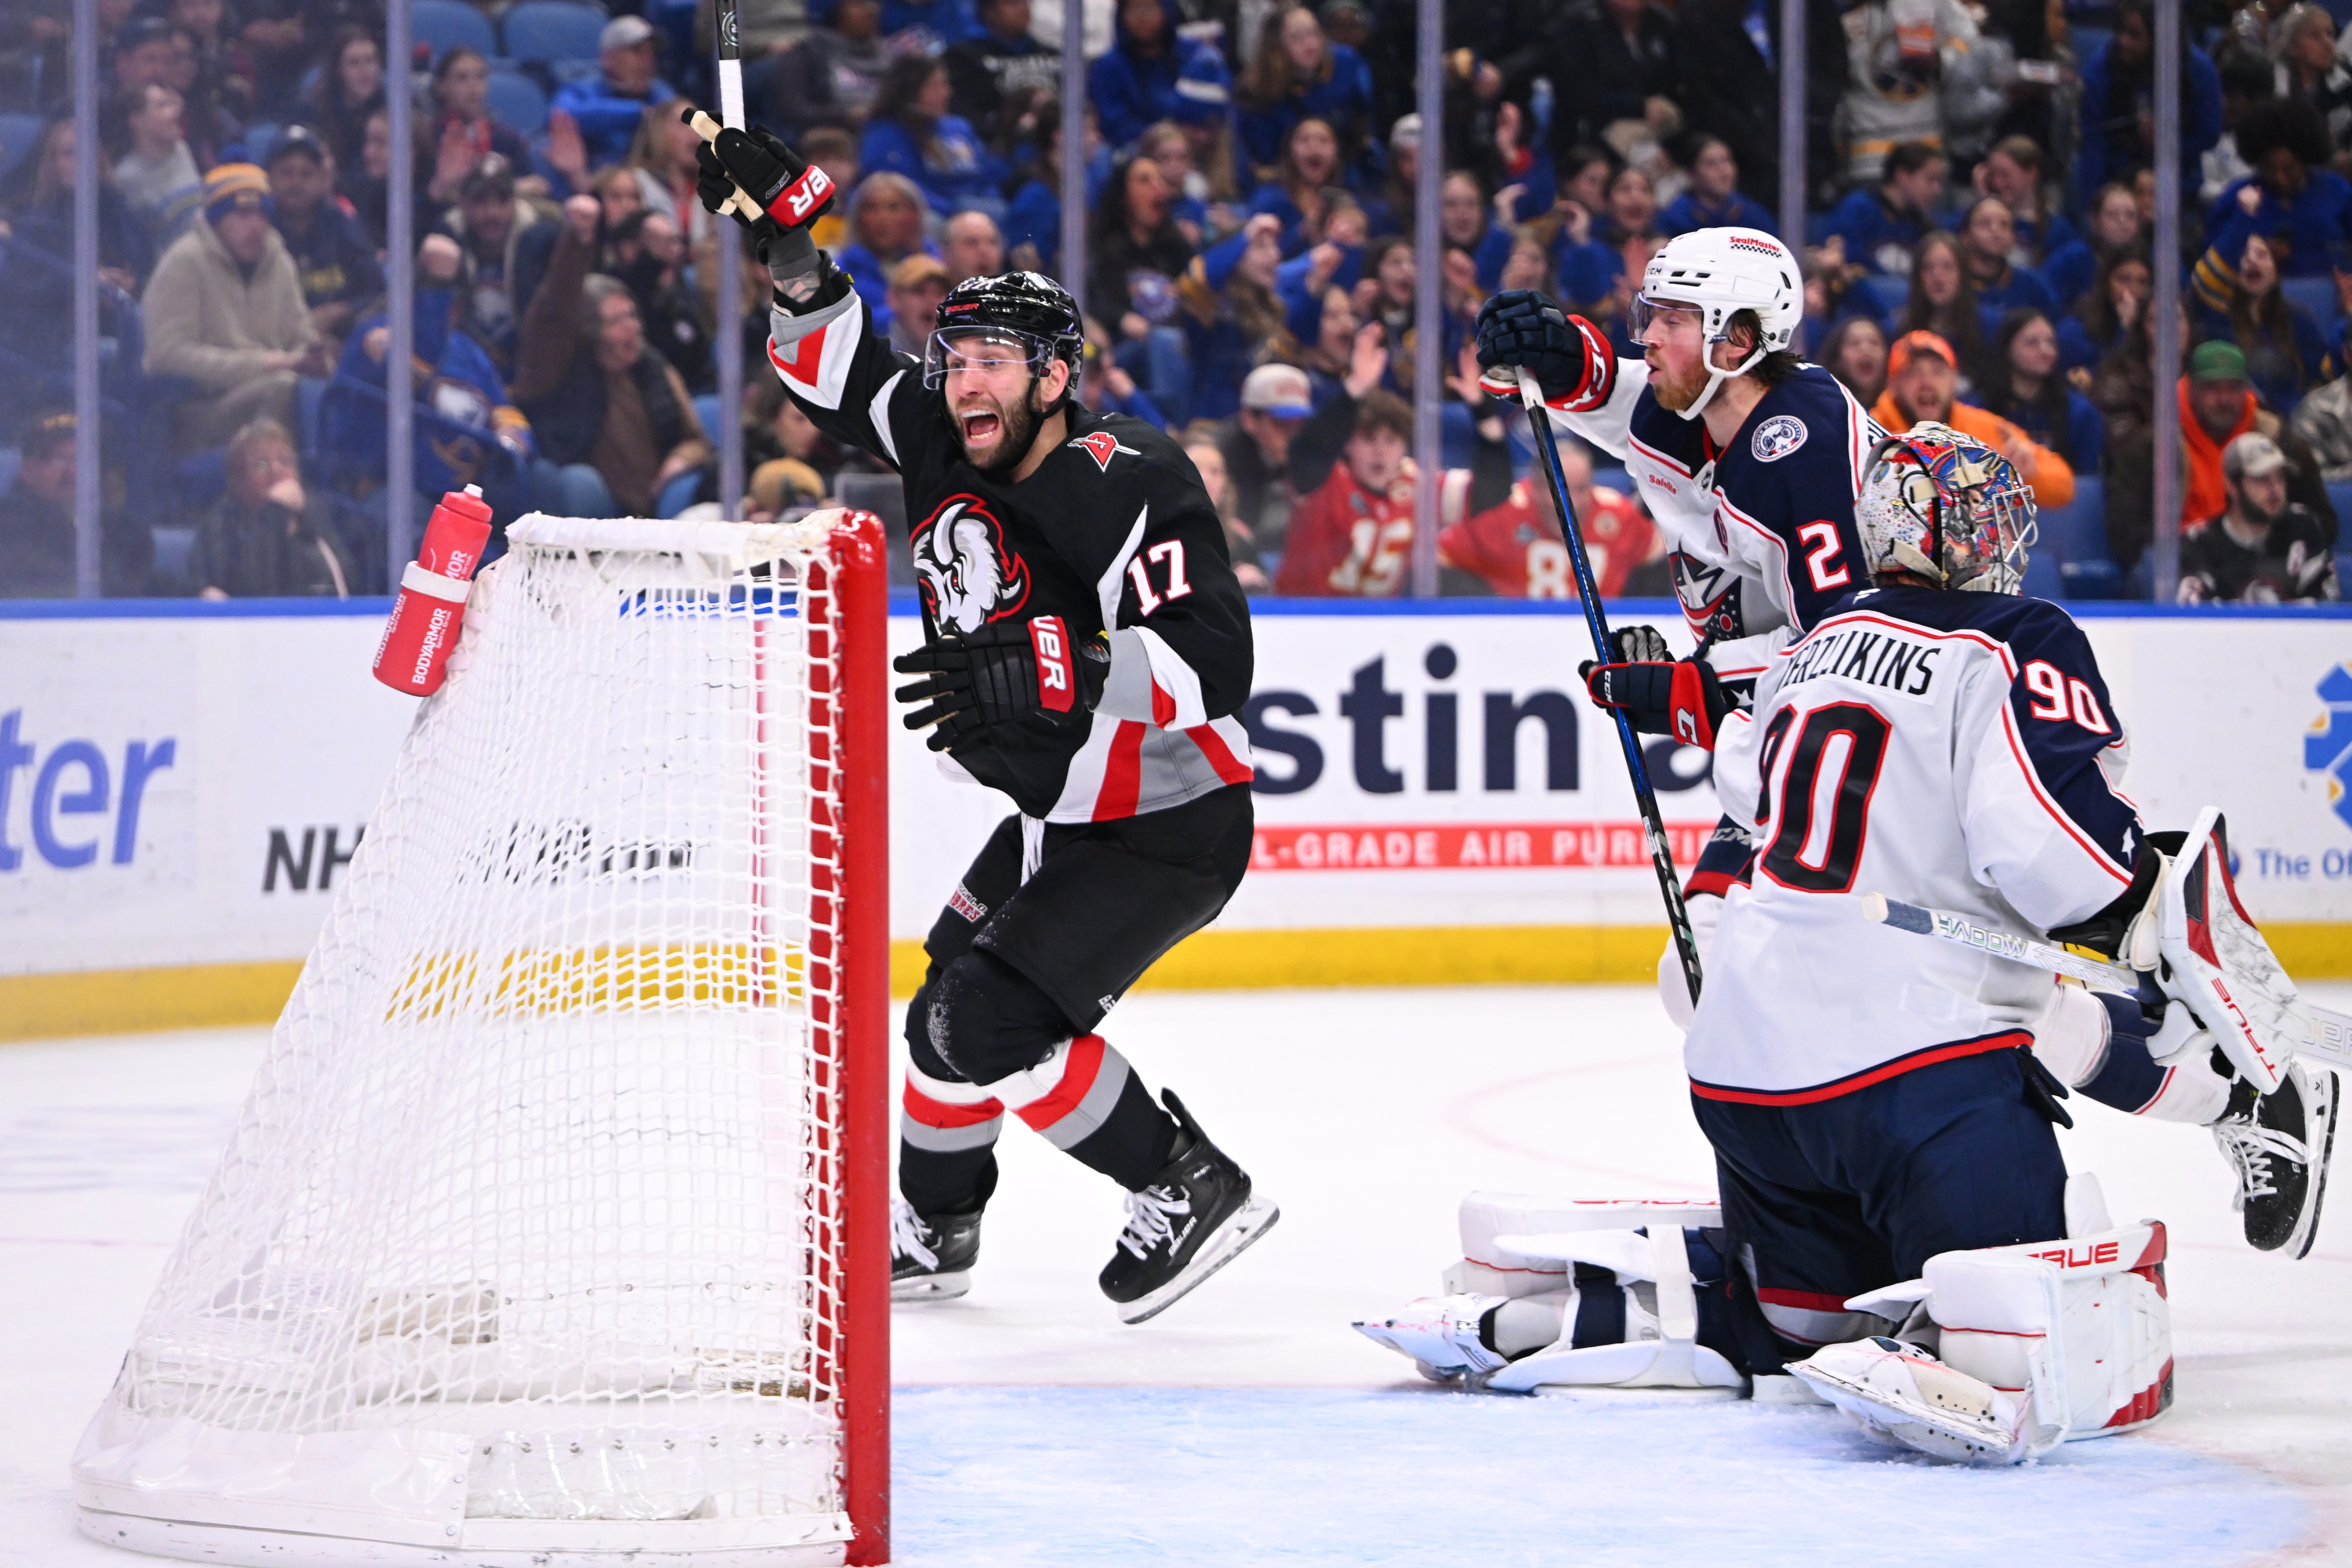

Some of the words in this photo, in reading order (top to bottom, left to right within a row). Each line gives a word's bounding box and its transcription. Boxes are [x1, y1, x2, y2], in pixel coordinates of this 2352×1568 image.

[1730, 236, 1780, 253] SealMaster
[945, 303, 980, 313] BAUER
[1649, 474, 1677, 495] Safelite
[1795, 519, 1851, 592] 2
[1127, 538, 1193, 617] 17
[441, 611, 452, 627] Drink
[412, 608, 448, 684] BODYARMOR
[1775, 630, 1942, 696] ERZLIKINS
[2023, 659, 2114, 735] 90
[1459, 831, 1531, 864] AIR
[2255, 845, 2310, 877] The
[1168, 1215, 1198, 1257] BAUER
